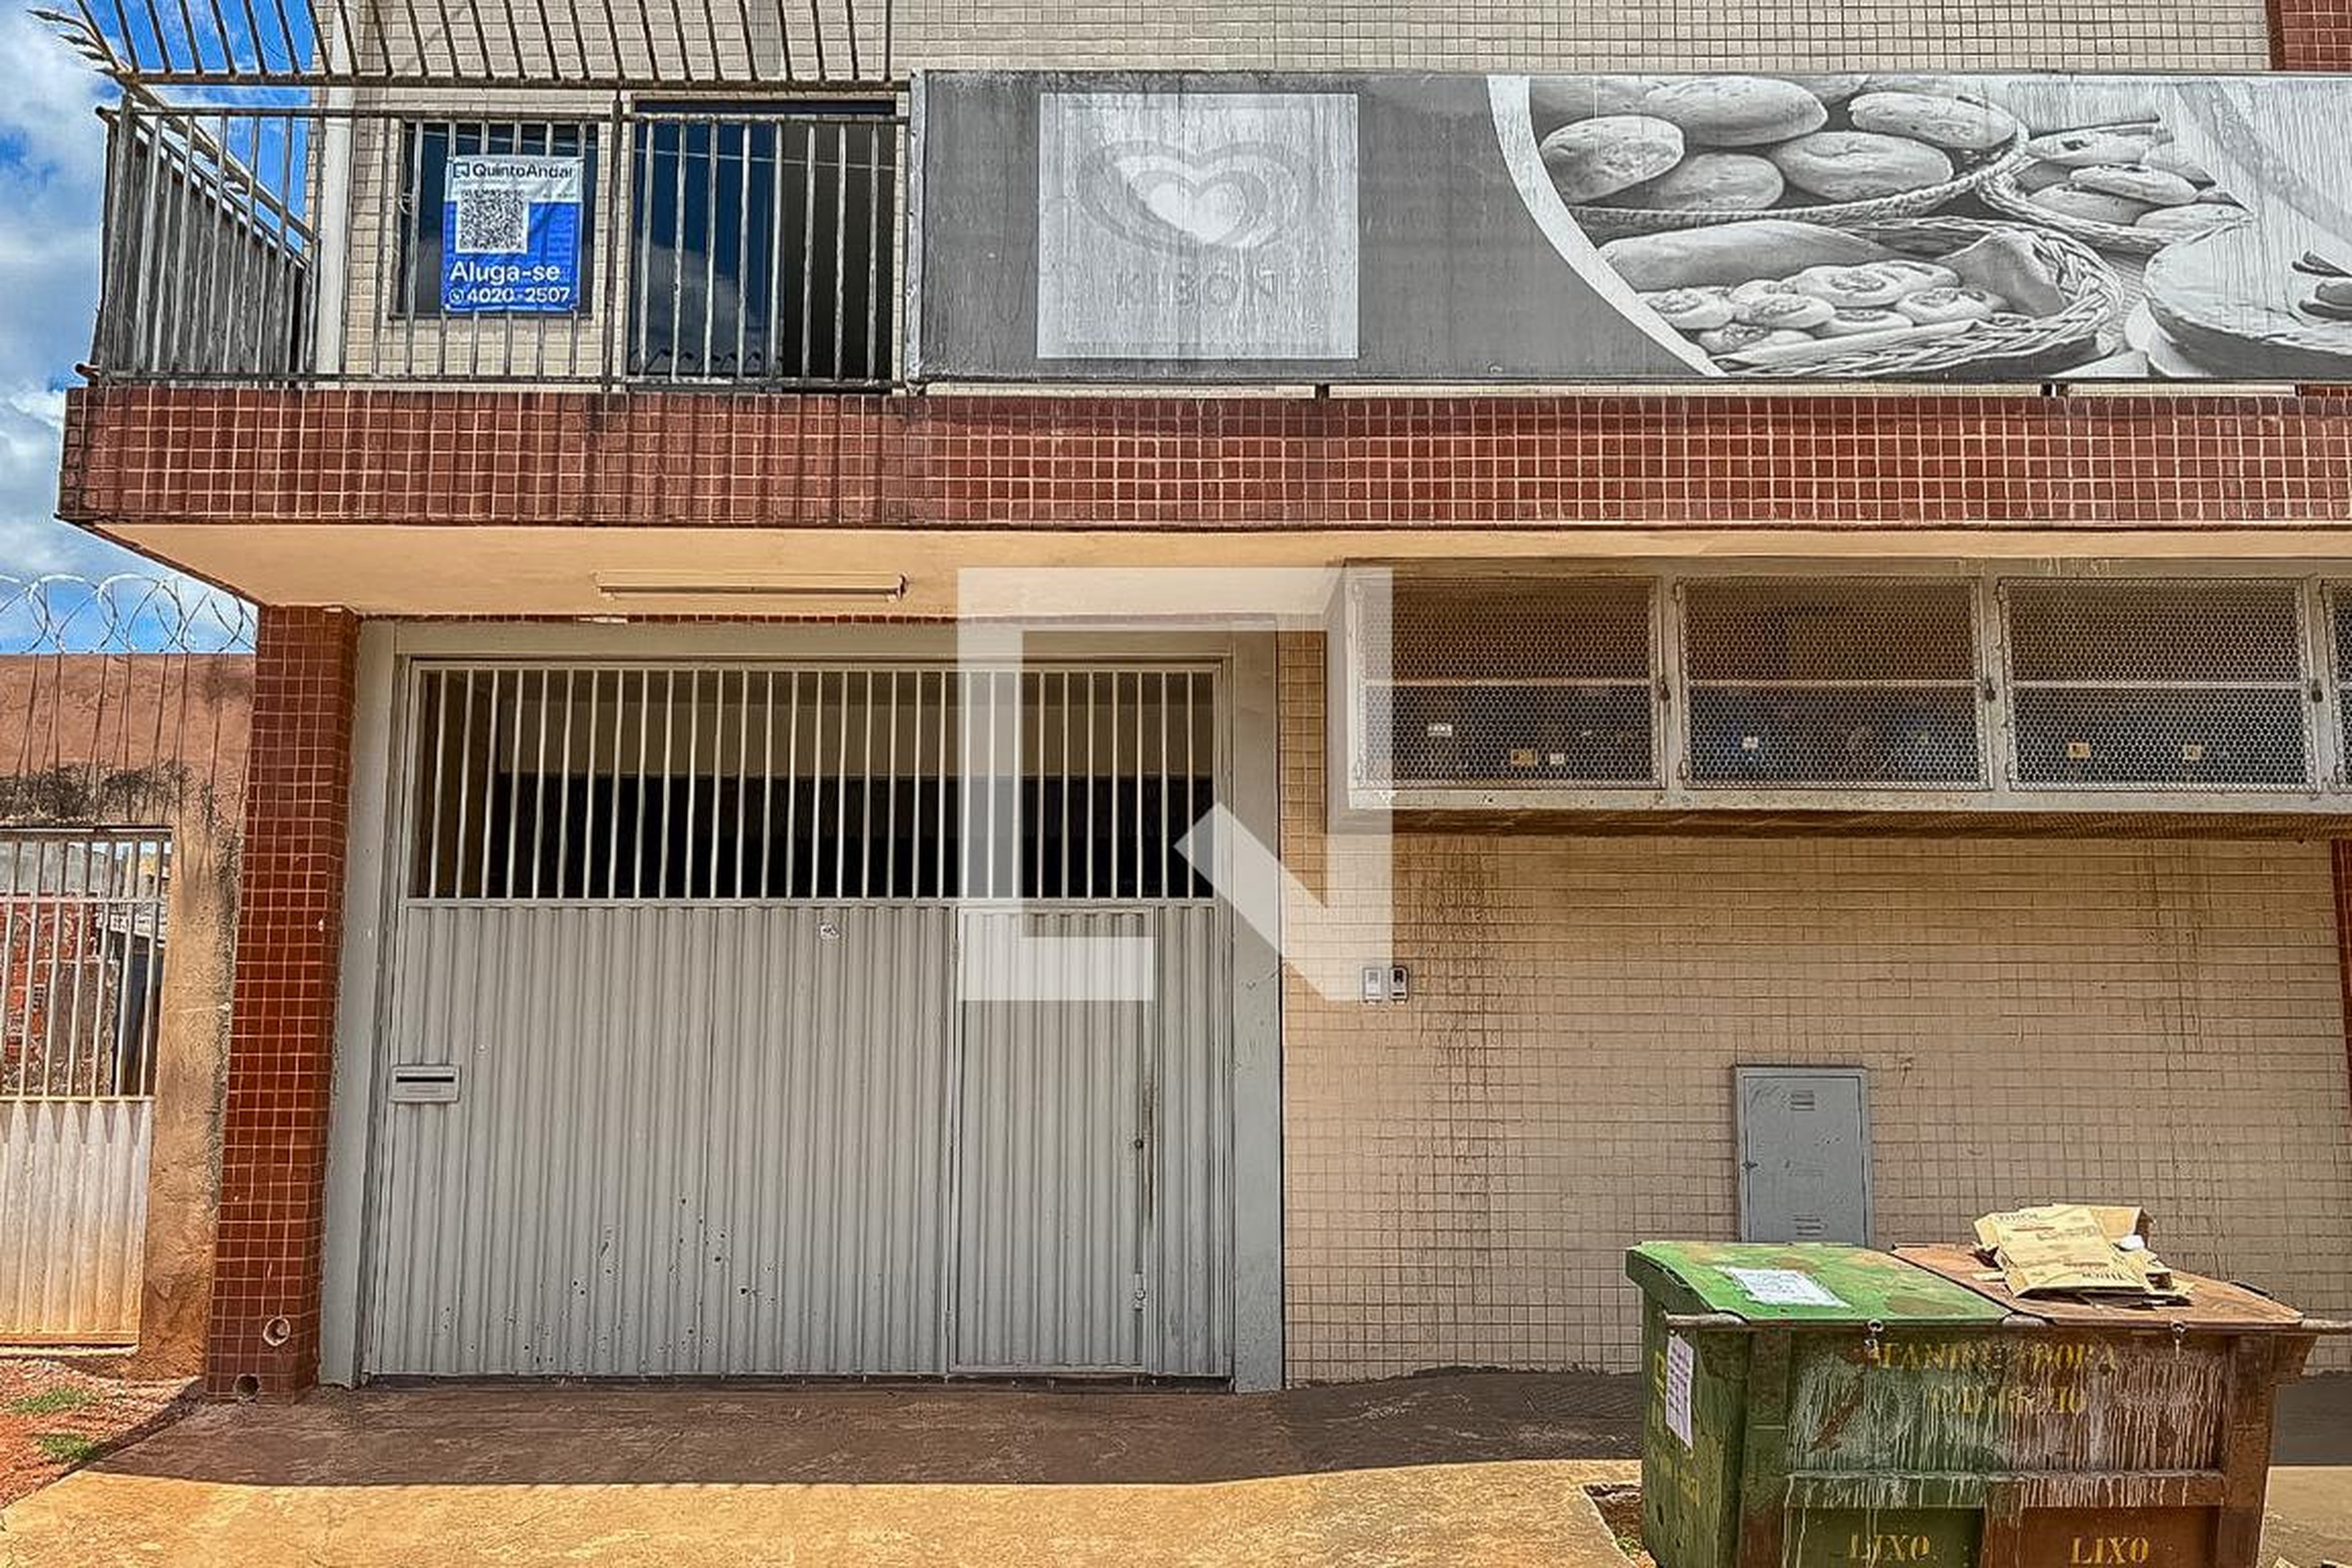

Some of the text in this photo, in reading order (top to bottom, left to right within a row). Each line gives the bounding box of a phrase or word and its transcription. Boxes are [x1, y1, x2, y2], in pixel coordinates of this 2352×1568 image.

[472, 163, 573, 178] QuintoAndar
[450, 261, 560, 286] Aluga-se
[467, 287, 570, 303] 4020-2507
[1849, 1534, 1930, 1561] LIXO
[2070, 1537, 2149, 1564] LIXO
